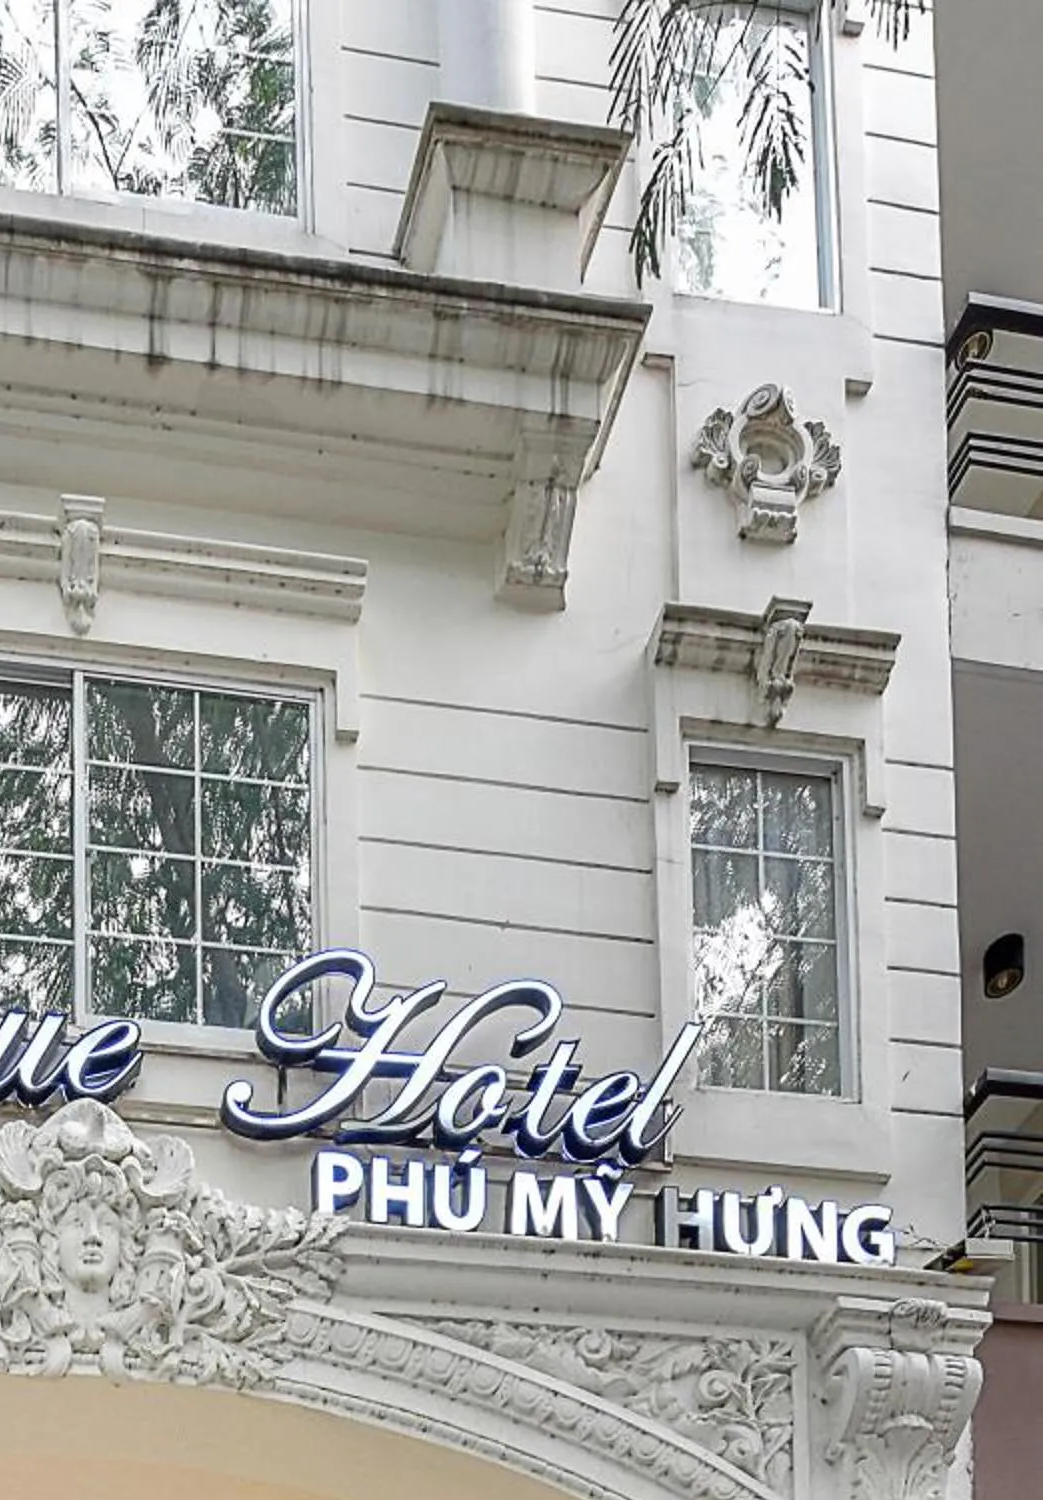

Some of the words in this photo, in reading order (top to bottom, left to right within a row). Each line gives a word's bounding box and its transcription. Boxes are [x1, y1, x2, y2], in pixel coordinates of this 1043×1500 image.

[220, 947, 704, 1168] Hotel
[312, 1149, 487, 1231] PHÚ
[508, 1166, 634, 1243] MỸ
[657, 1184, 896, 1265] HƯNG
